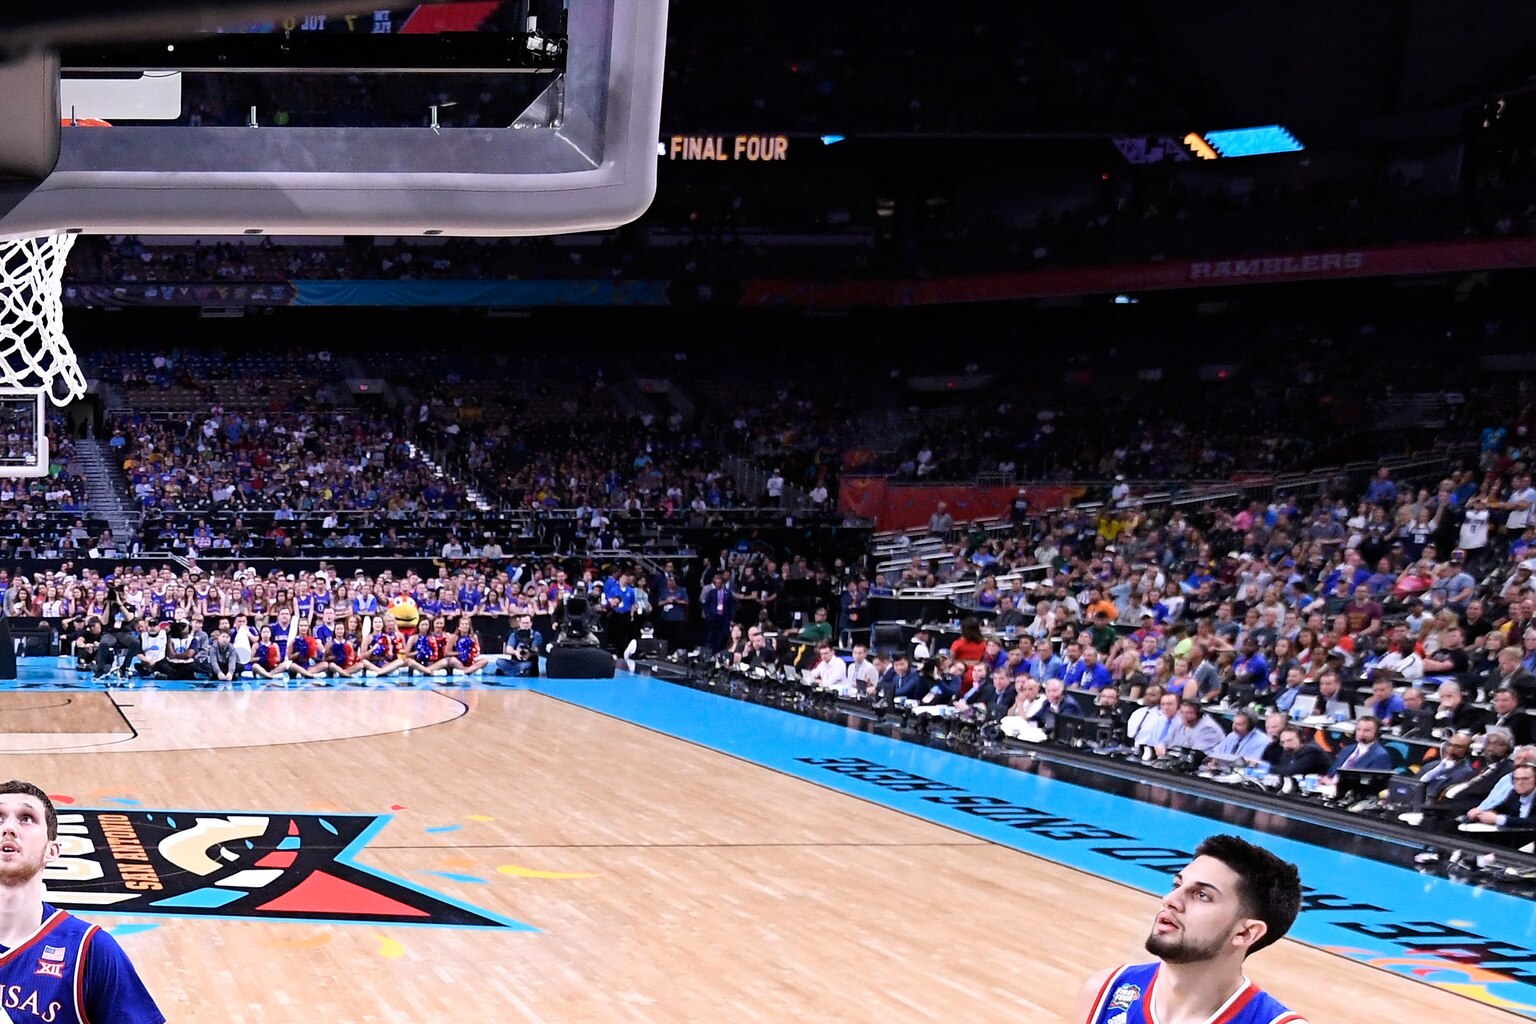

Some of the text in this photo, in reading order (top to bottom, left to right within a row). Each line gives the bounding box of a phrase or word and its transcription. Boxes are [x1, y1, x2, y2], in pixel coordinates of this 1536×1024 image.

[670, 136, 788, 161] FINAL FOUR
[1189, 252, 1363, 280] RAMBLERS
[97, 814, 164, 891] SAN ANTONIO
